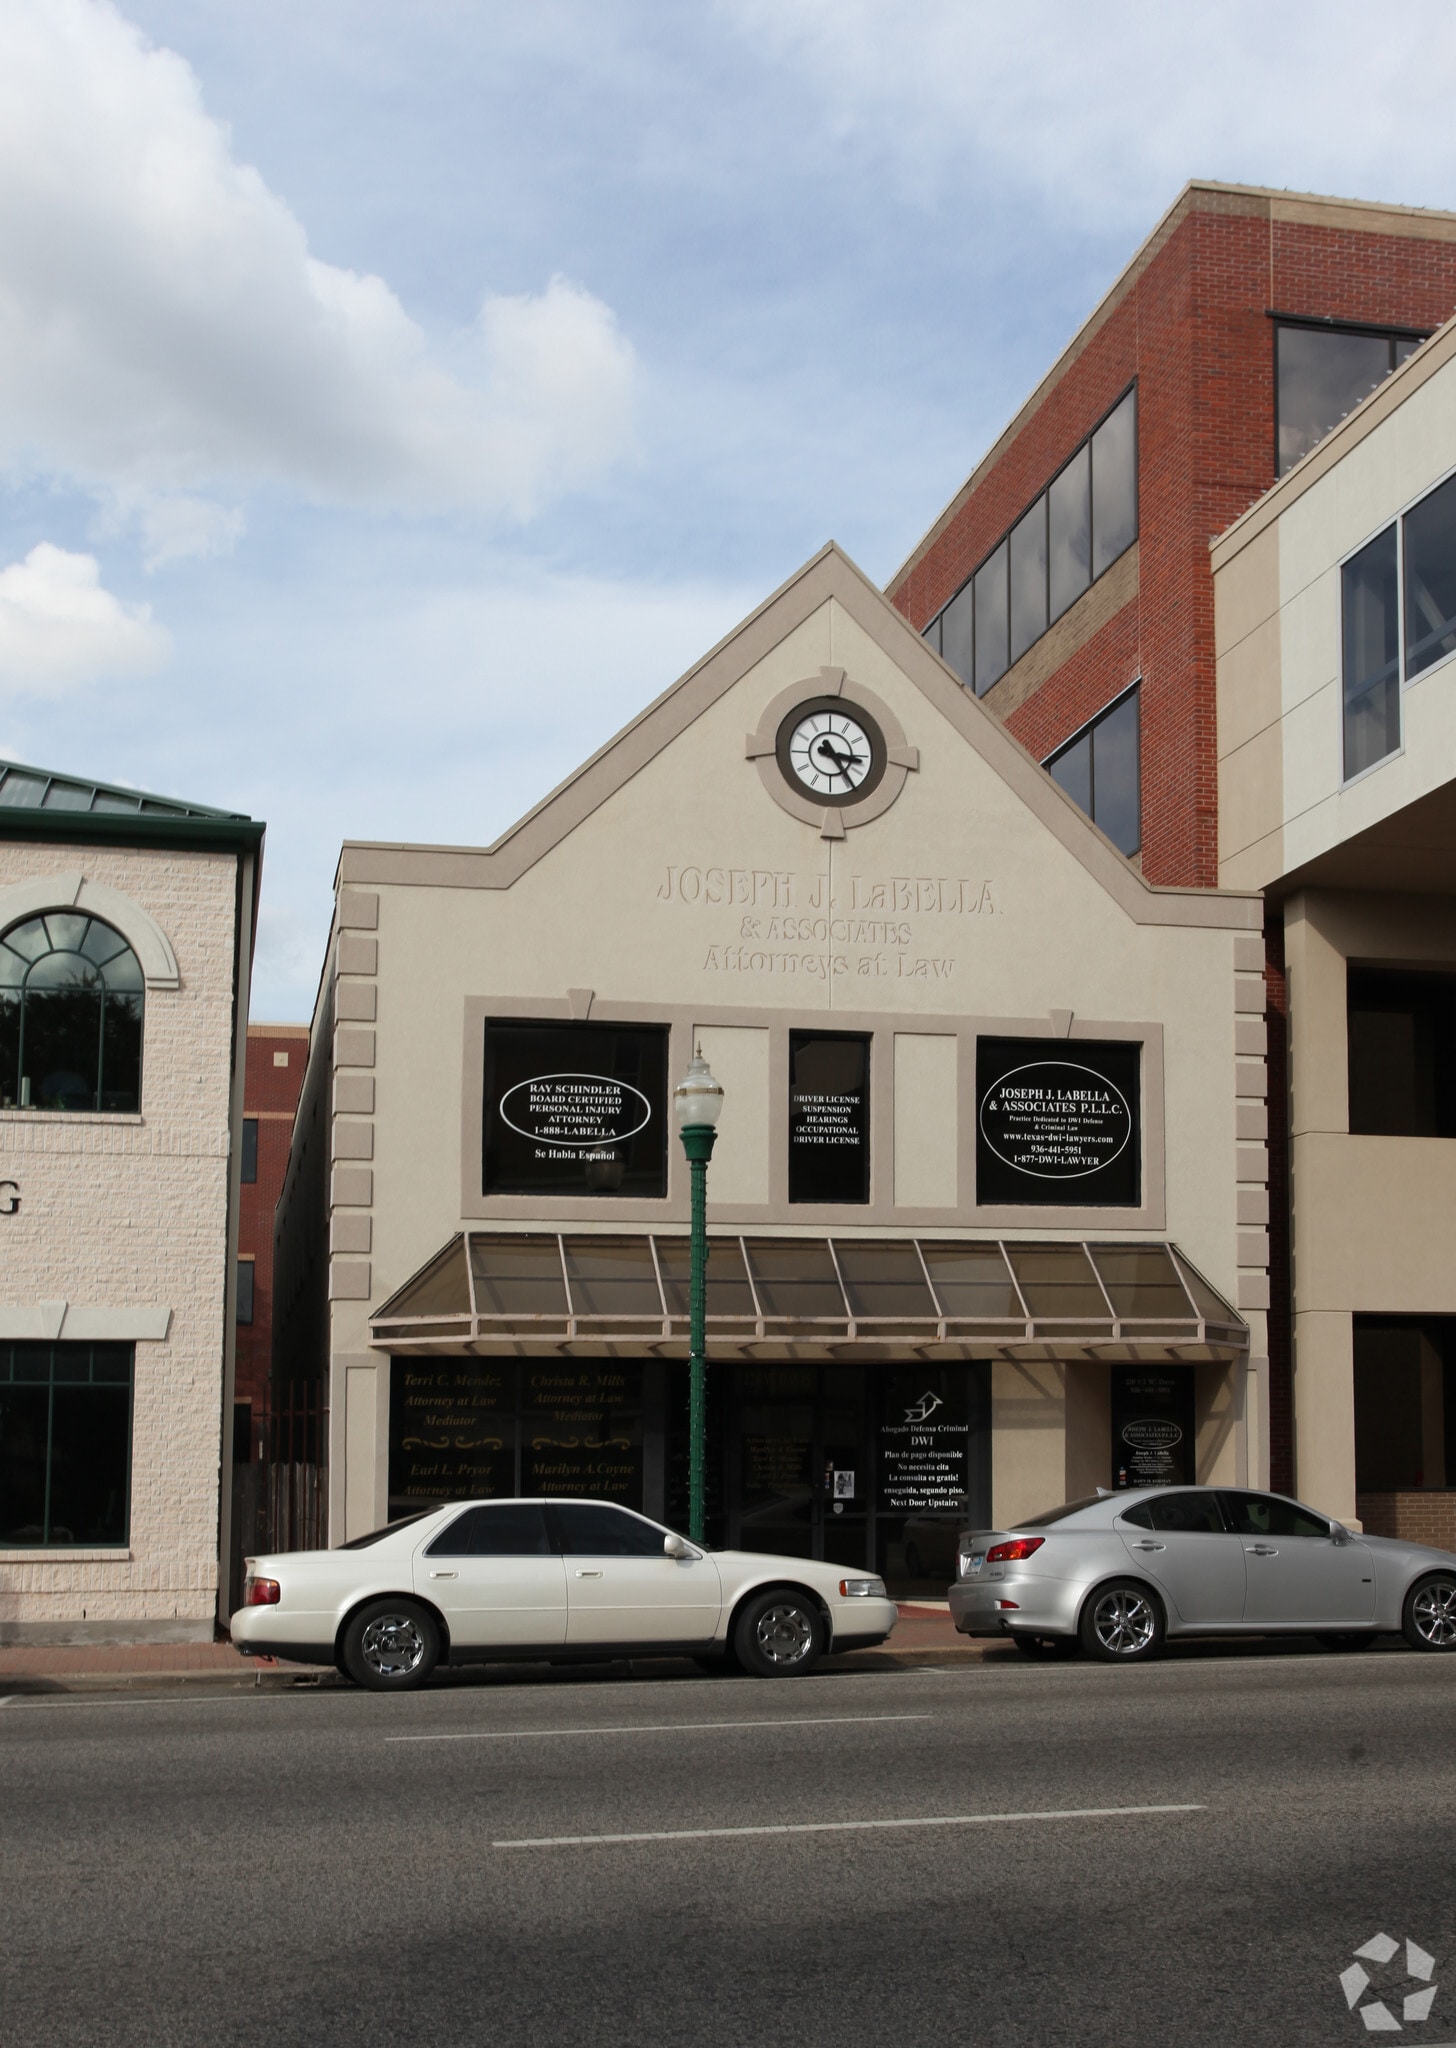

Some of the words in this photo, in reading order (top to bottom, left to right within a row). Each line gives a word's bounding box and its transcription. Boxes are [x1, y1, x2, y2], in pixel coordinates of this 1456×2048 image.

[657, 866, 797, 908] JOSEPH
[809, 874, 836, 909] J.
[850, 876, 1004, 914] LaBELLA
[740, 916, 759, 939] &
[766, 917, 912, 945] ASSOCIATES
[703, 945, 848, 980] Attorneys
[857, 954, 887, 976] at
[898, 953, 955, 979] Law
[530, 1084, 552, 1093] RAY
[555, 1084, 620, 1094] SCHINDLER
[794, 1095, 824, 1103] DRIVER
[826, 1096, 860, 1104] LICENSE
[1000, 1088, 1043, 1099] JOSEPH
[1046, 1089, 1054, 1100] J.
[1058, 1090, 1109, 1101] LABELLA
[530, 1095, 565, 1103] BOARD
[568, 1096, 621, 1105] CERTIFIED
[530, 1105, 583, 1113] PERSONAL
[585, 1106, 622, 1114] INJURY
[989, 1101, 997, 1110] &
[1002, 1101, 1076, 1112] ASSOCIATES
[1081, 1103, 1122, 1114] P.L.L.C.
[548, 1116, 603, 1124] ATTORNEY
[535, 1126, 616, 1136] 1-888-LABELLA
[796, 1126, 858, 1134] OCCUPATIONAL
[1003, 1133, 1113, 1144] www.texas-dwi-lawyers.com
[1031, 1145, 1081, 1154] 936-441-5951
[535, 1149, 545, 1158] Se
[549, 1150, 575, 1159] Habla
[579, 1150, 615, 1161] Español
[1014, 1155, 1099, 1165] 1-877-DWI-LAWYER
[404, 1374, 432, 1386] Terri
[437, 1375, 449, 1386] C.
[454, 1375, 502, 1386] Mendez
[531, 1375, 575, 1386] Christa
[596, 1375, 625, 1386] Mills
[406, 1396, 454, 1408] Attorney
[458, 1397, 468, 1406] at
[472, 1396, 496, 1406] Law
[534, 1393, 582, 1405] Attorney
[585, 1394, 596, 1403] at
[600, 1393, 624, 1403] Law
[424, 1414, 477, 1426] Mediator
[553, 1411, 604, 1421] Mediator
[881, 1426, 909, 1434] Abogado
[911, 1436, 933, 1446] DWI
[928, 1451, 963, 1459] disponible
[410, 1464, 438, 1475] Earl
[442, 1464, 452, 1475] L.
[458, 1464, 493, 1477] Pryor
[532, 1463, 580, 1476] Marilyn
[937, 1474, 958, 1482] gratis!
[403, 1485, 451, 1497] Attorney
[455, 1486, 466, 1495] at
[470, 1485, 495, 1495] Law
[538, 1481, 586, 1493] Attorney
[590, 1482, 601, 1491] at
[604, 1481, 628, 1491] Law
[920, 1487, 947, 1495] segundo
[909, 1498, 926, 1506] Door
[928, 1498, 958, 1507] Upstairs
